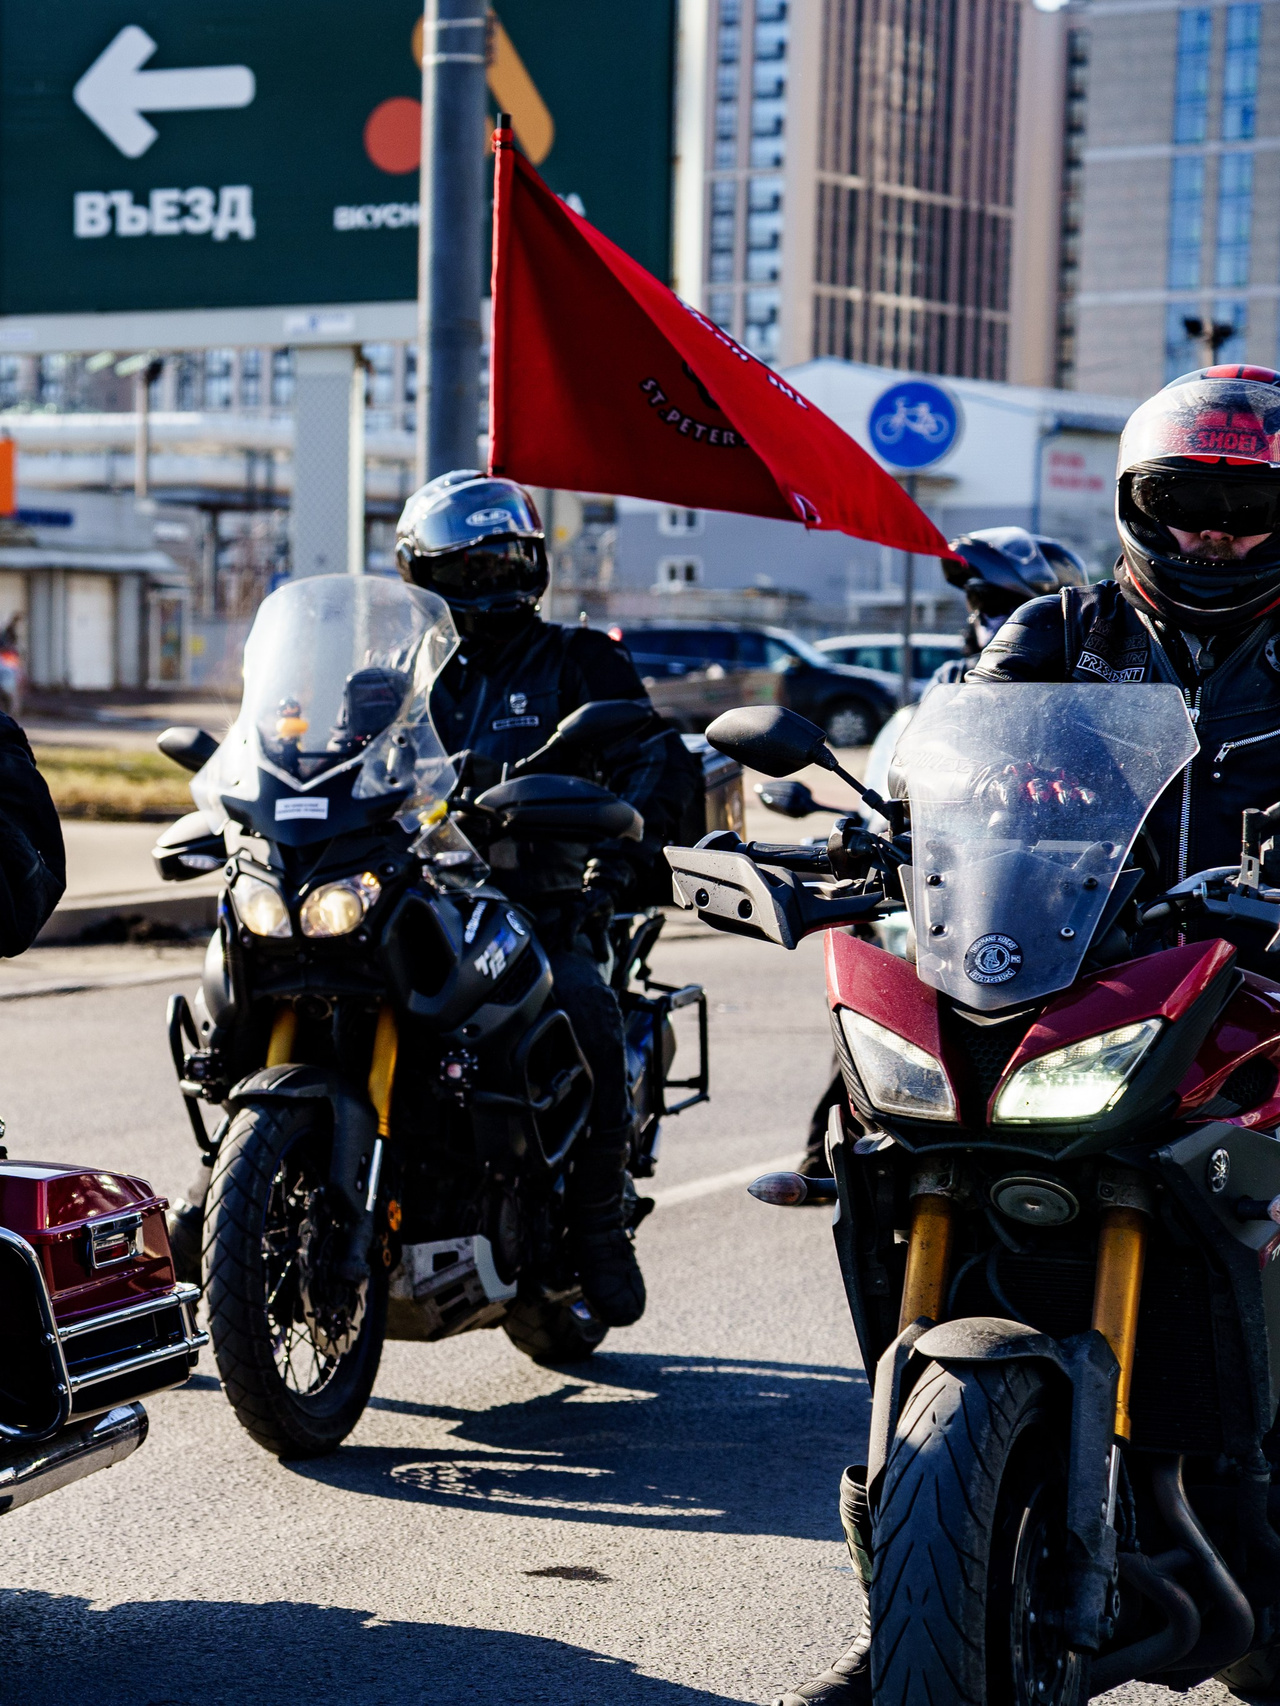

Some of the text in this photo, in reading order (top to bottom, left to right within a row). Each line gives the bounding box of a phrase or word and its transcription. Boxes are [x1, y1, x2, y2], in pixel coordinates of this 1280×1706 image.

[74, 186, 255, 241] ВЪЕЗД
[1195, 430, 1258, 452] SHOEI
[1081, 654, 1141, 682] PRESIDENT
